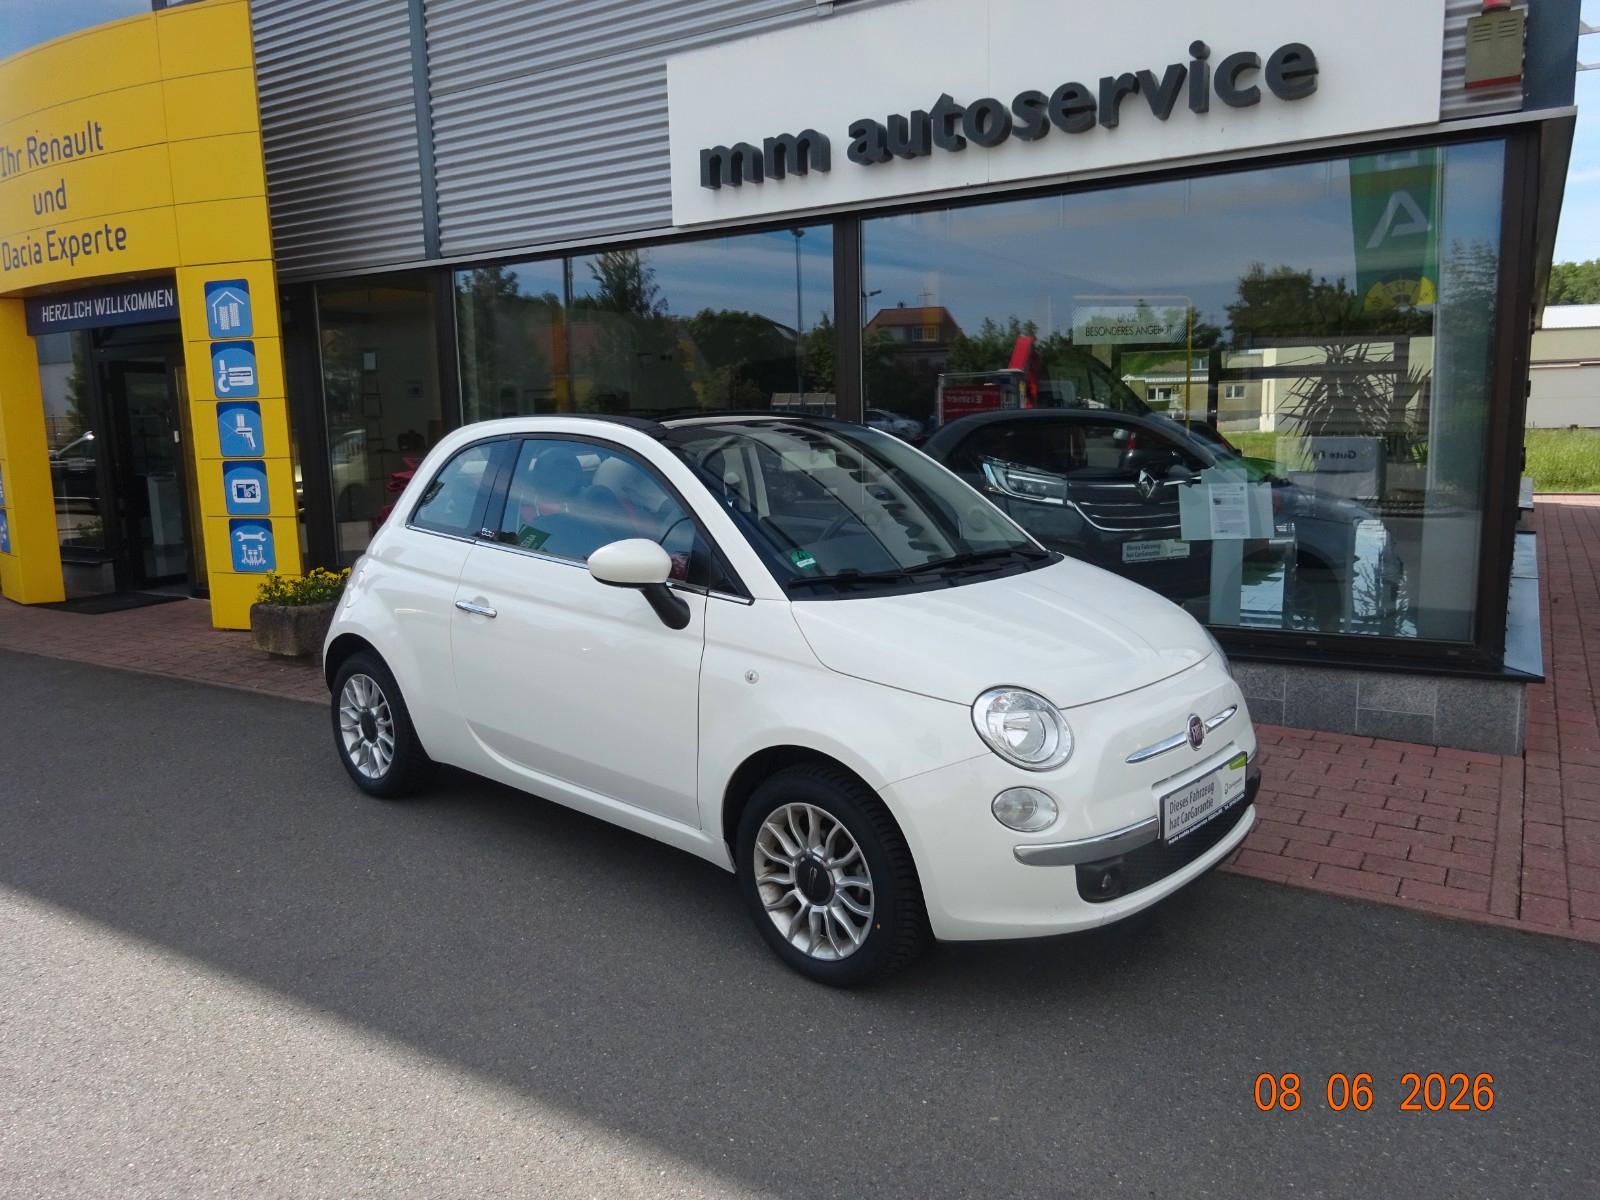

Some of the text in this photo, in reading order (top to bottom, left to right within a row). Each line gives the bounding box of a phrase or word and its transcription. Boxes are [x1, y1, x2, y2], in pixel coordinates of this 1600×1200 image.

[700, 39, 1319, 190] mm autoservice
[0, 120, 104, 177] Ihr Renault
[33, 178, 67, 215] und
[2, 223, 127, 271] Dacia Experte
[42, 288, 173, 322] HERZLICH WILLKOMMEN
[1085, 326, 1134, 337] BESONDERES
[1169, 796, 1189, 814] Dieses
[1190, 782, 1214, 804] Fahrzeug
[1169, 816, 1180, 831] hat
[1181, 798, 1214, 824] CarGarantie
